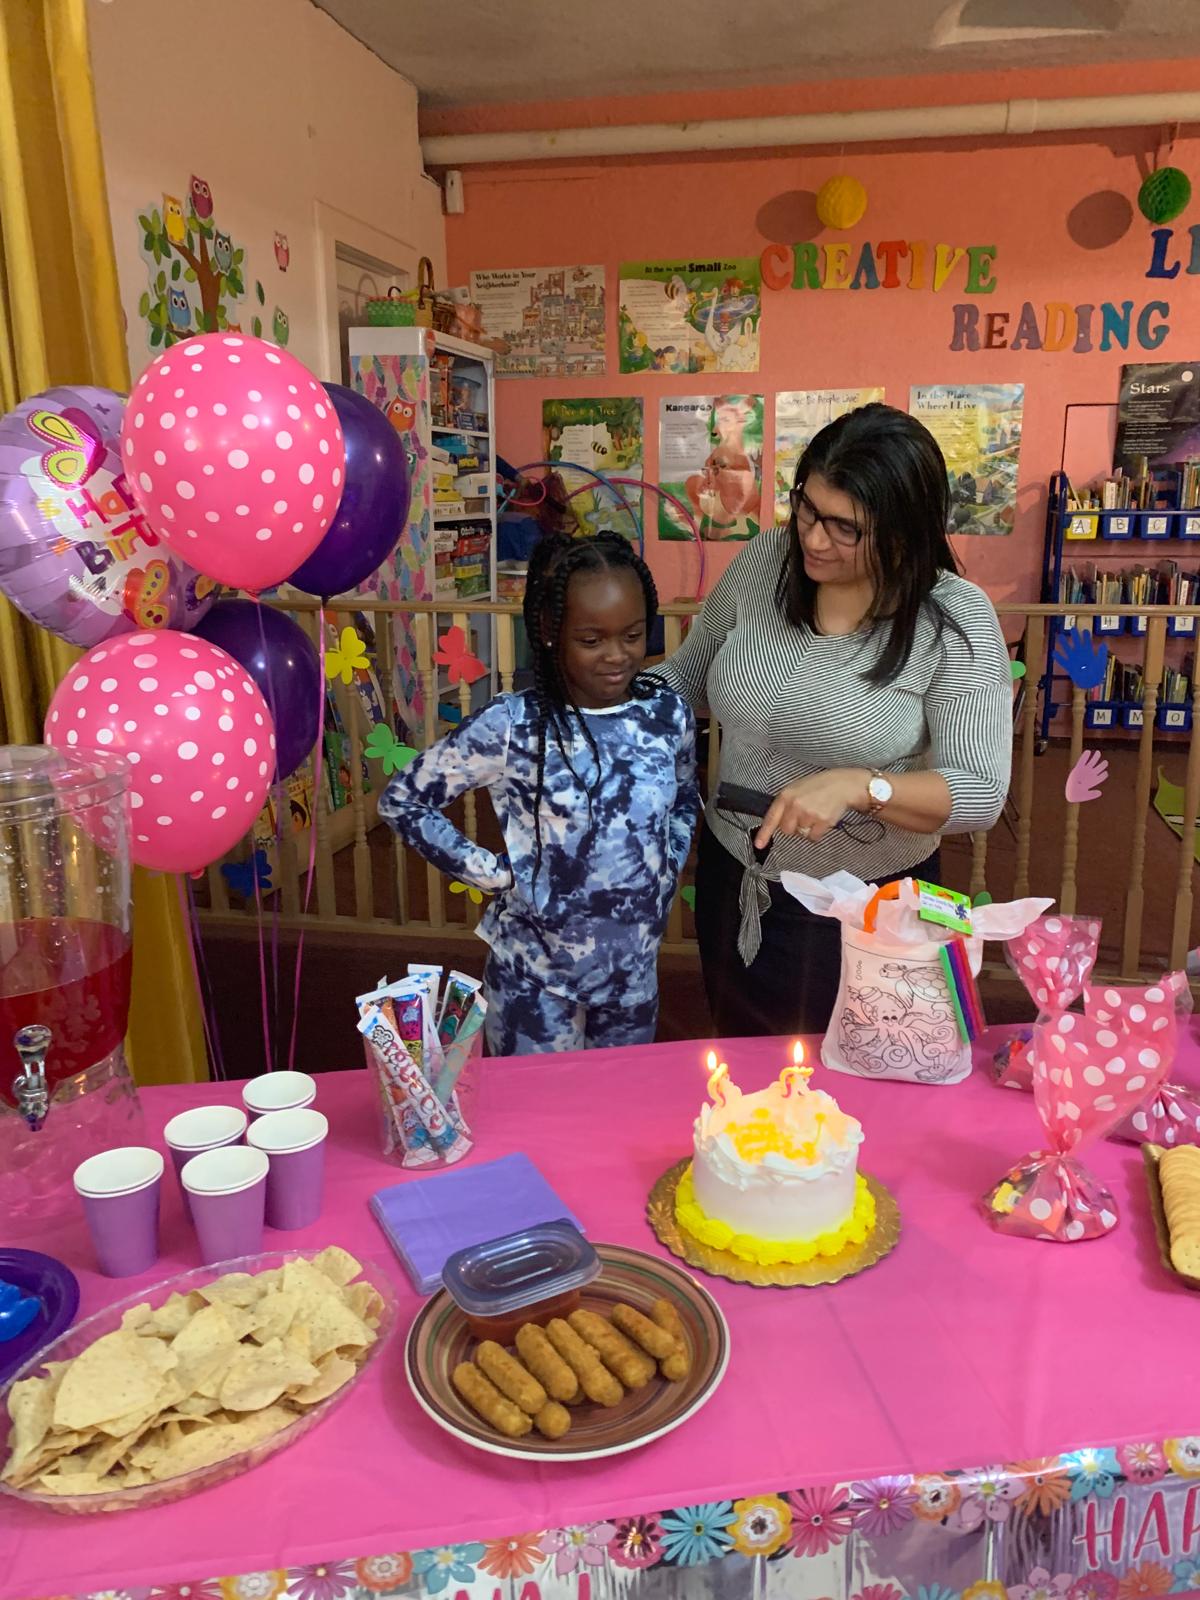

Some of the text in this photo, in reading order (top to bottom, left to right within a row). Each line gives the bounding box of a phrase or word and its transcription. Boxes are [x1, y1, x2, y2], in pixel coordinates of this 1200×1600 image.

[688, 262, 722, 273] Small
[759, 240, 997, 294] CREATIVE
[949, 301, 1170, 353] READING
[917, 391, 927, 399] In
[947, 390, 972, 399] Place
[1129, 382, 1171, 395] Stars
[665, 404, 713, 412] Kangaroo
[917, 401, 947, 409] Where
[956, 401, 977, 409] Live
[1074, 519, 1085, 534] A
[1116, 518, 1125, 531] B
[1153, 518, 1161, 532] C
[1104, 616, 1112, 627] H
[1096, 711, 1106, 722] M
